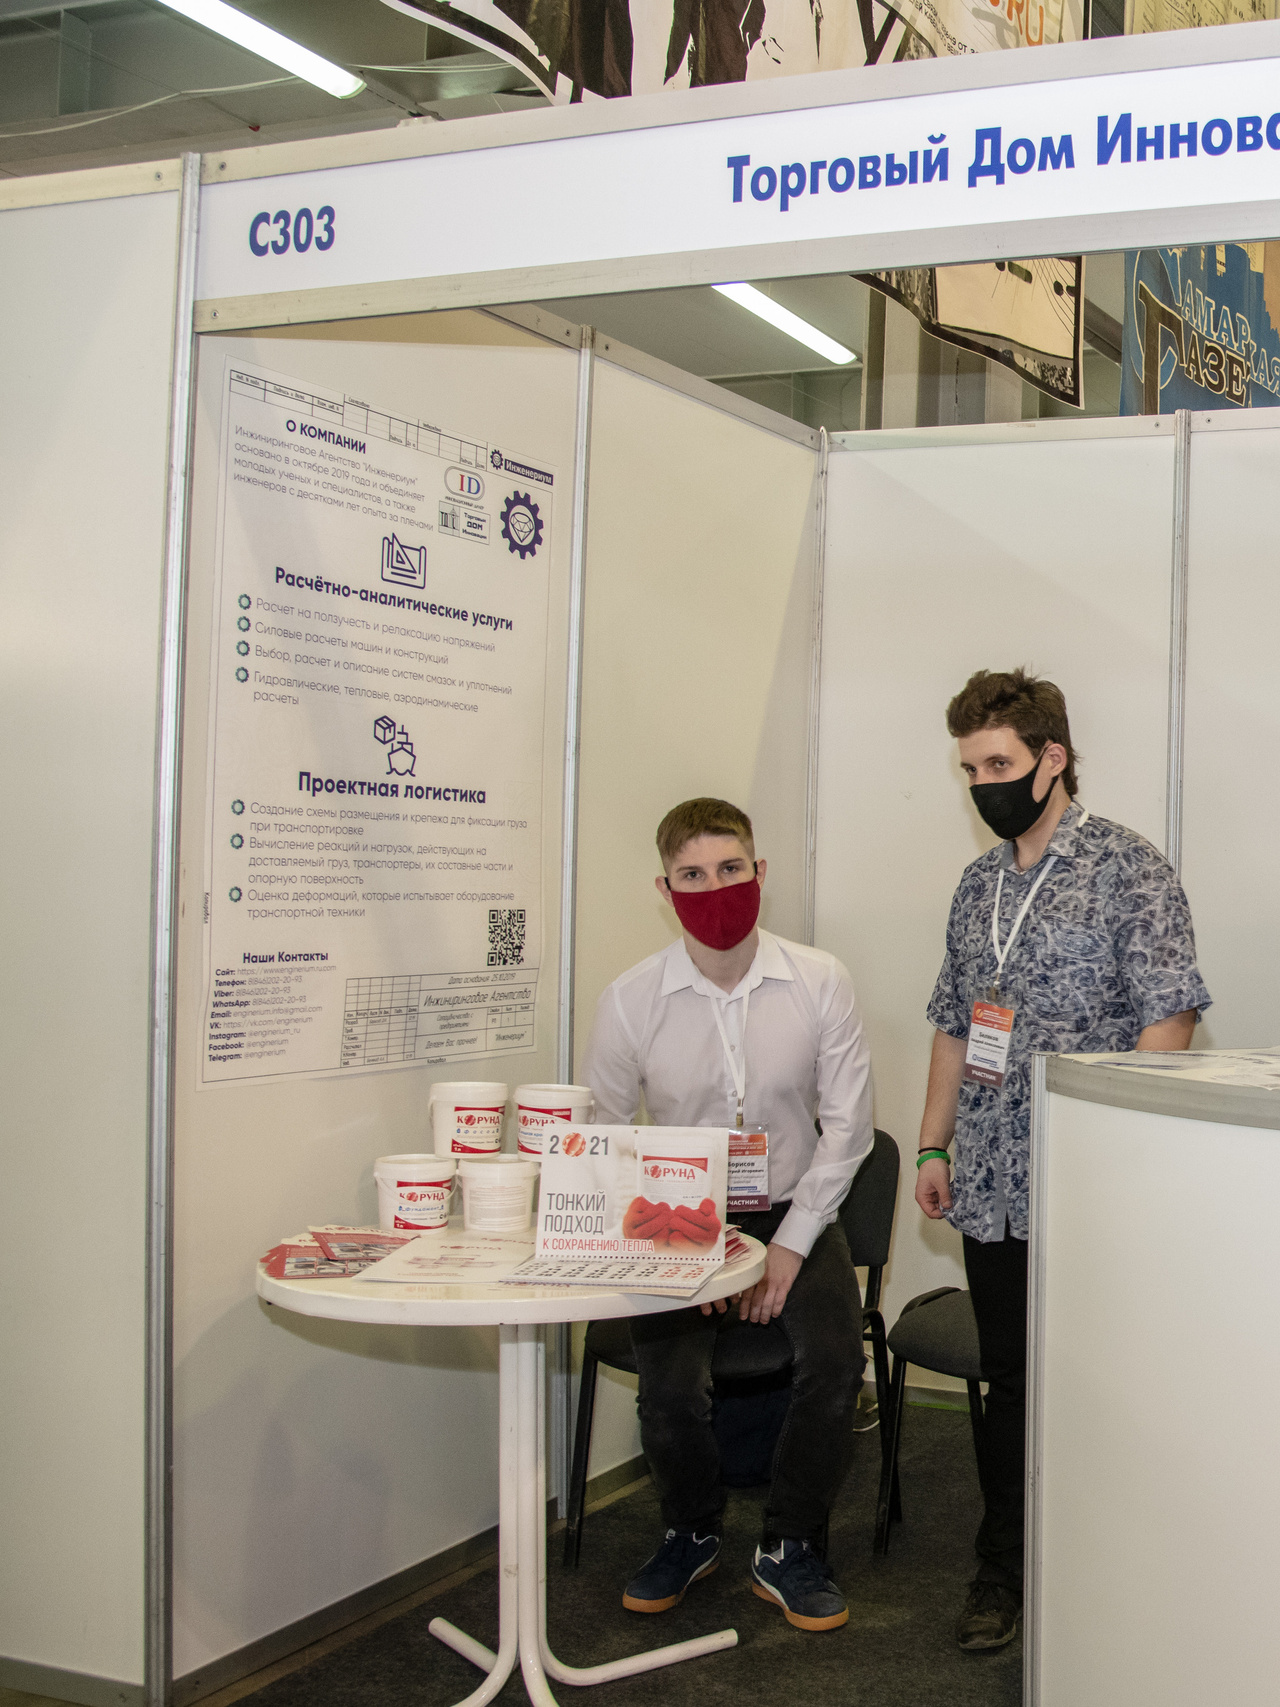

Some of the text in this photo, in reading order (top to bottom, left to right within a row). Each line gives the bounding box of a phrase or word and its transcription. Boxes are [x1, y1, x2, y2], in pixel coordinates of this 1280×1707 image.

[727, 134, 949, 212] Торговый
[967, 126, 1075, 189] Дом
[235, 425, 316, 457] Инжиниринговое
[318, 449, 361, 471] Агентство
[286, 419, 297, 433] О
[300, 423, 366, 454] КОМПАНИИ
[234, 442, 282, 463] основано
[284, 456, 290, 465] в
[292, 457, 329, 477] октябре
[331, 466, 350, 481] 2019
[351, 473, 371, 488] года
[379, 482, 425, 503] объединяет
[234, 457, 276, 476] молодых
[278, 468, 312, 486] ученых
[322, 479, 383, 505] специалистов,
[392, 499, 416, 513] также
[506, 460, 552, 484] Инженериум
[233, 472, 287, 494] инженеров
[297, 489, 344, 508] десятками
[346, 500, 360, 511] лет
[362, 503, 387, 520] опыта
[389, 512, 398, 522] за
[400, 515, 434, 532] плечами
[275, 566, 513, 631] Расчётно-аналитические услуги
[256, 597, 294, 616] Расчет
[297, 608, 311, 619] на
[314, 610, 371, 630] ползучесть
[381, 623, 441, 643] релаксацию
[443, 635, 496, 653] напряжений
[255, 622, 449, 665] Силовые расчеты машин конструкций
[255, 645, 513, 695] Выбор, расчет описание систем смазок уплотнений
[253, 691, 299, 705] расчеты
[254, 671, 479, 713] Гидравлические, тепловые, аэродинамические
[298, 771, 486, 804] Проектная логистика
[249, 822, 364, 836] при транспортировке
[250, 802, 304, 817] Создание
[306, 807, 337, 818] схемы
[339, 809, 400, 822] размещения
[410, 813, 449, 825] крепежа
[450, 816, 465, 826] для
[467, 815, 505, 828] фиксации
[507, 819, 528, 830] груза
[249, 836, 487, 857] Вычисление реакций нагрузок, действующих на
[248, 856, 507, 871] доставляемый груз, транспортеры, их составные части
[248, 874, 364, 887] опорную поверхность
[247, 889, 515, 903] Оценка деформаций, которые испытывает оборудование
[247, 907, 365, 920] транспортной техники
[243, 951, 329, 963] Наши Контакты
[547, 1190, 606, 1212] ТОНКИЙ
[544, 1215, 604, 1235] ПОДХОД
[543, 1238, 654, 1253] К СОХРАНЕНИЮ ТЕПЛА
